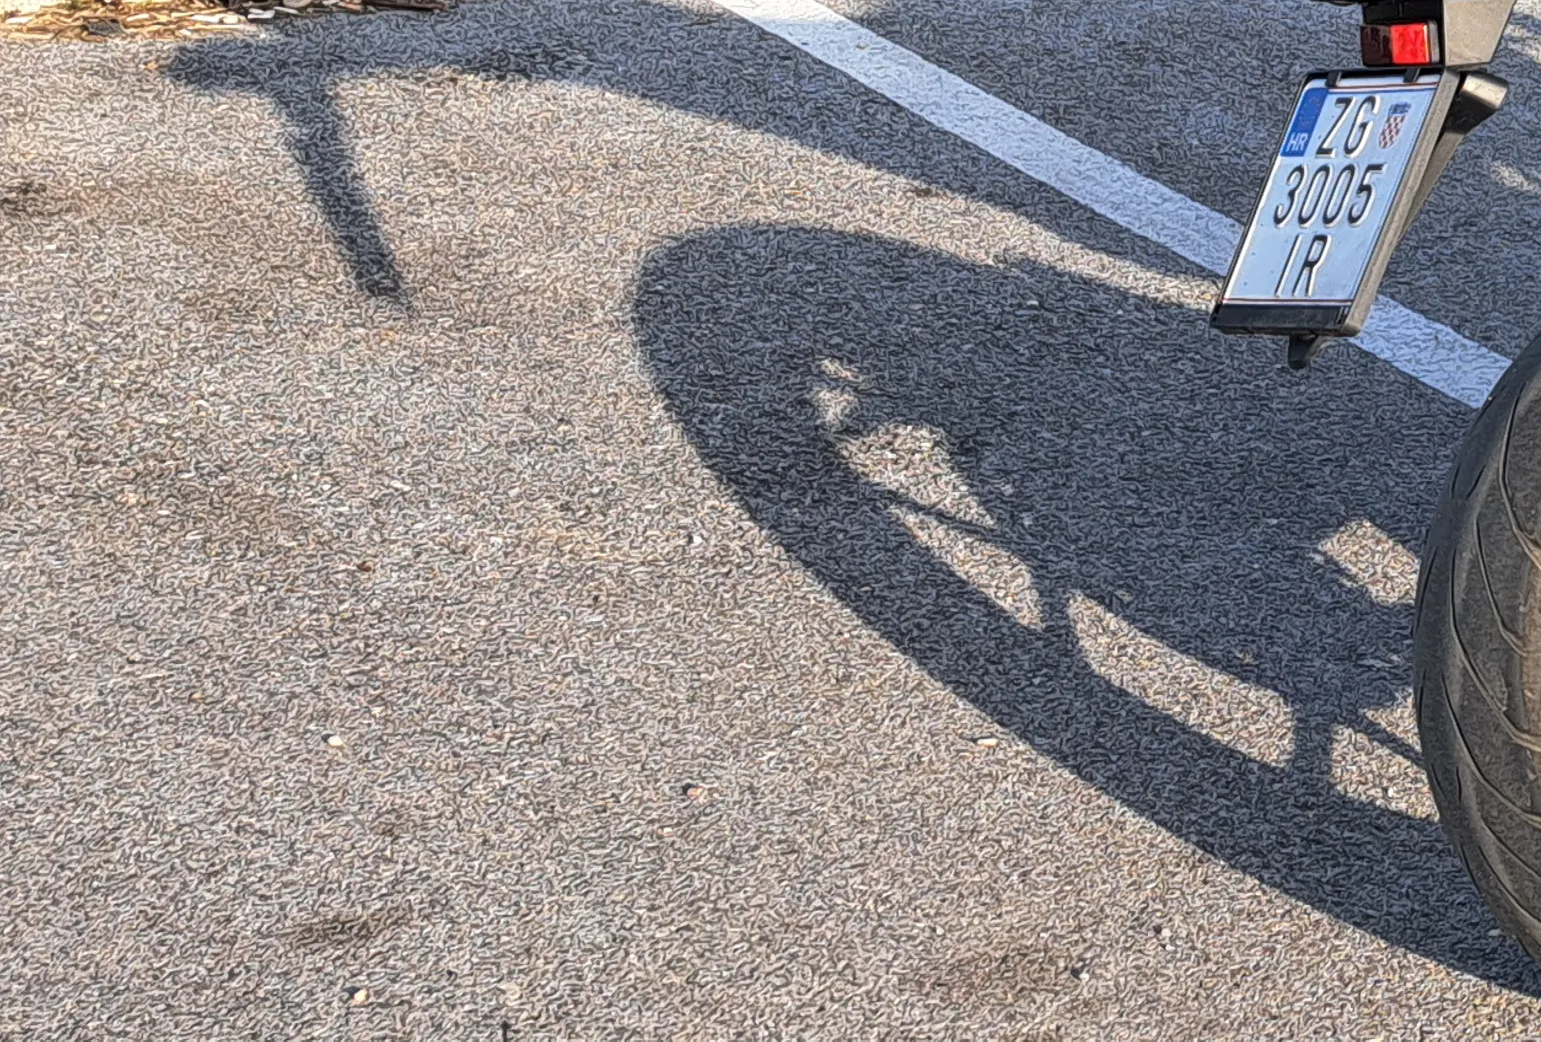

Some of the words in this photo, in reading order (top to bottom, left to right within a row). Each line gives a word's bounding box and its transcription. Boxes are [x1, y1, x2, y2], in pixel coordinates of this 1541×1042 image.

[1285, 132, 1309, 152] HR
[1315, 95, 1381, 158] ZG
[1273, 163, 1387, 228] 3005
[1275, 234, 1332, 297] IR
